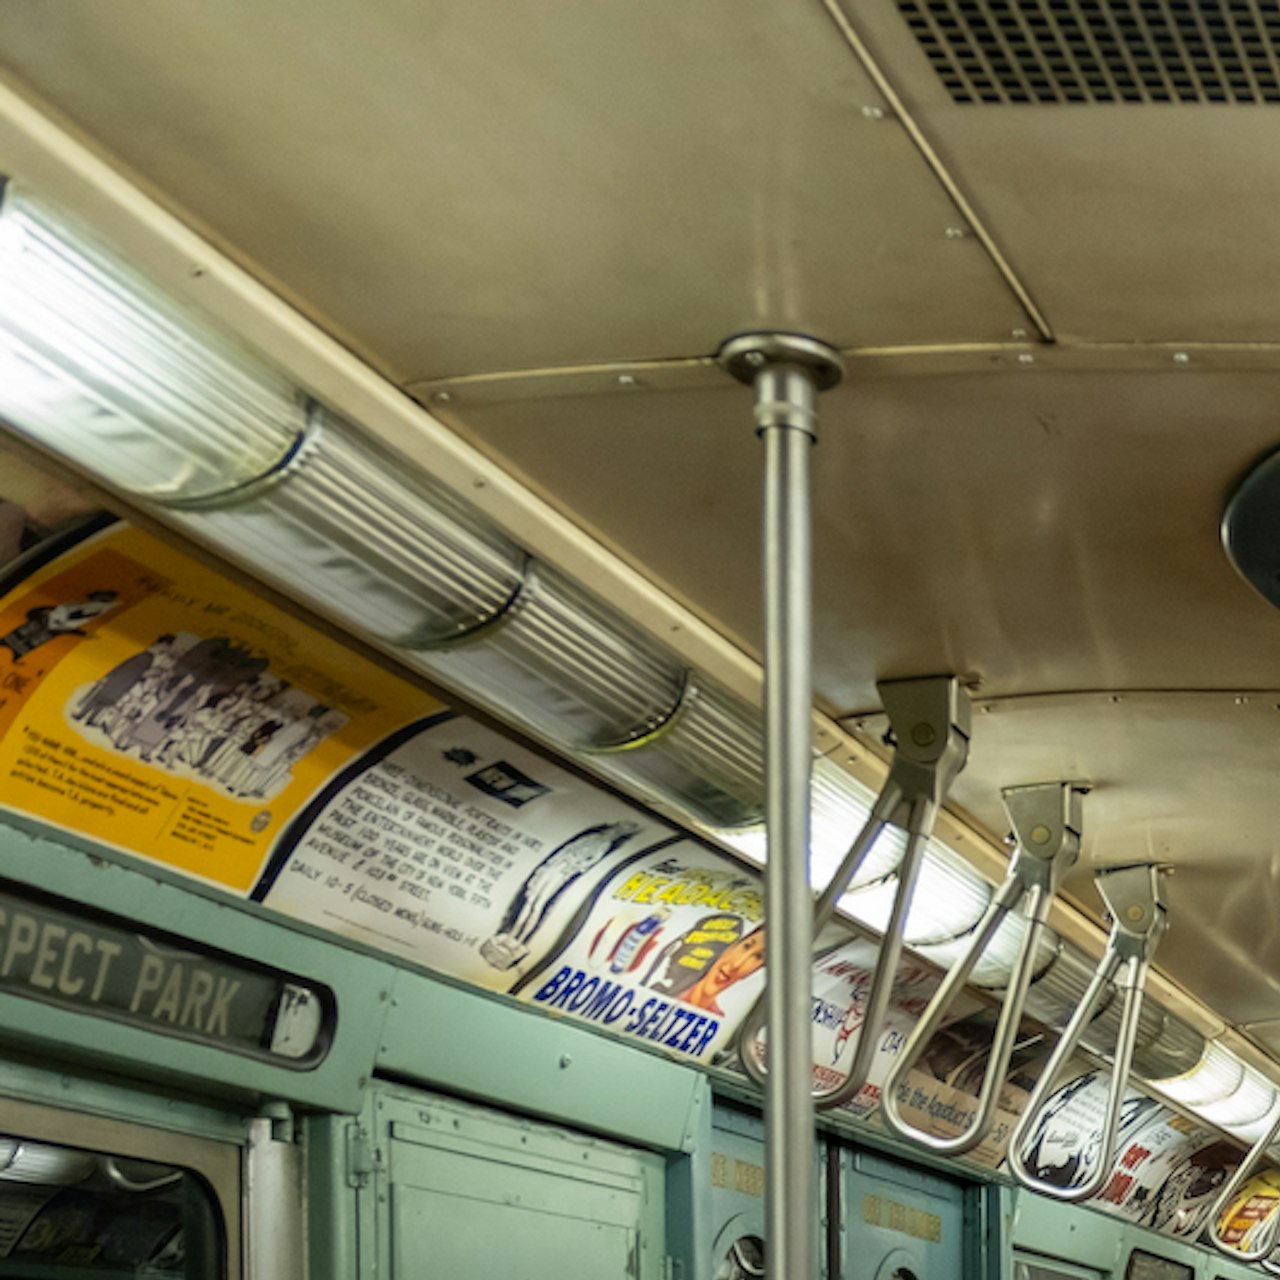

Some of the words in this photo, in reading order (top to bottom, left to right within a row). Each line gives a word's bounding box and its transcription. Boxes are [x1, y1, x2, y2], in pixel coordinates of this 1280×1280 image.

[325, 808, 359, 831] PAST
[338, 796, 366, 816] THE
[303, 835, 351, 864] AVENUE
[314, 822, 365, 853] MUSEUM
[361, 844, 380, 860] OF
[378, 853, 399, 870] THE
[287, 857, 325, 882] DAILY
[0, 908, 122, 1002] PECT
[128, 954, 241, 1037] PARK
